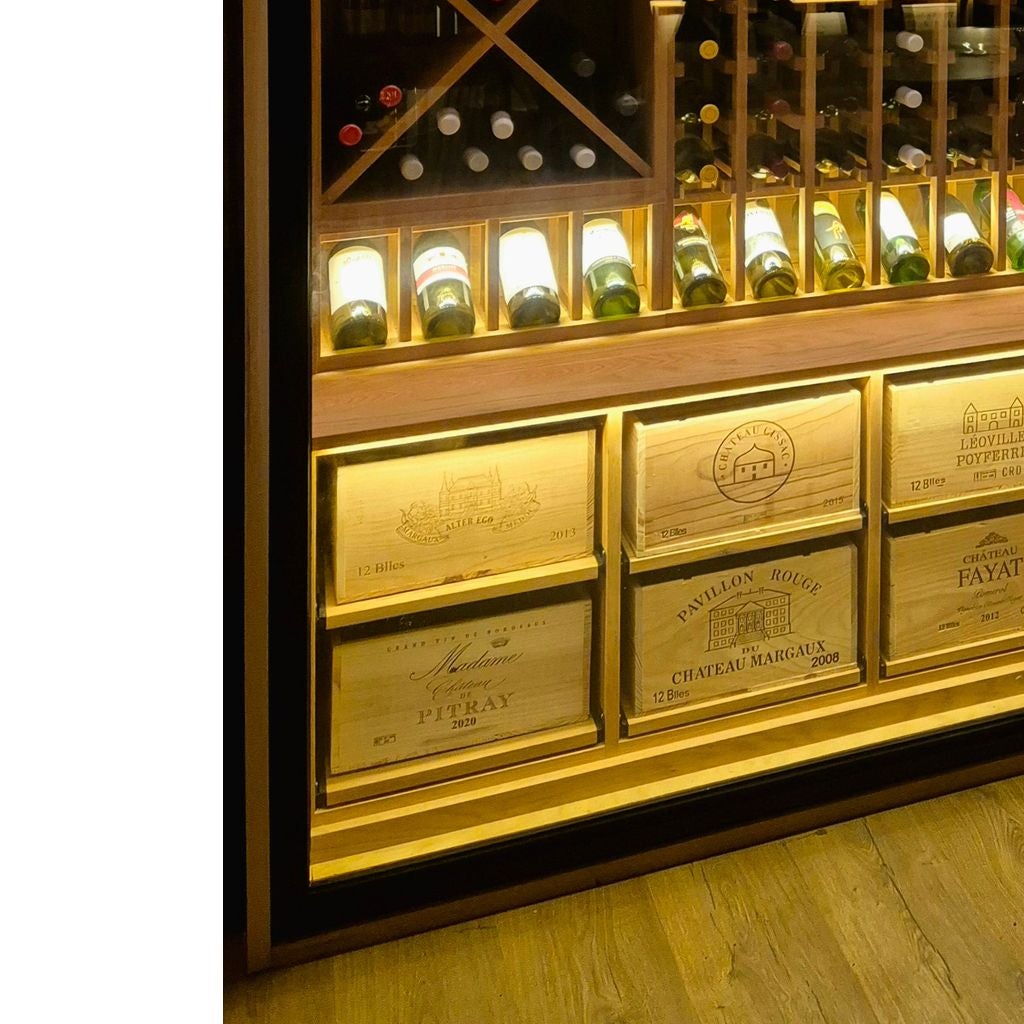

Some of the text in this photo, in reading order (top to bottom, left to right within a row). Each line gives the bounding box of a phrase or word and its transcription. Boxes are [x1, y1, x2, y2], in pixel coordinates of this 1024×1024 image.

[910, 480, 921, 492] 12
[446, 515, 494, 532] ALTER EGO
[550, 527, 576, 542] 2013
[358, 565, 371, 577] 12
[957, 557, 1024, 588] FAYAT
[677, 568, 823, 624] PAVILLON ROUGE
[980, 611, 1000, 623] 2012
[387, 641, 426, 652] GRAND
[742, 645, 759, 655] DU
[409, 641, 524, 681] Madame
[672, 640, 827, 686] CHATEAU MARGAUX
[811, 652, 840, 668] 2008
[653, 692, 664, 704] 12
[418, 691, 515, 725] PITRAY
[451, 716, 477, 730] 2020
